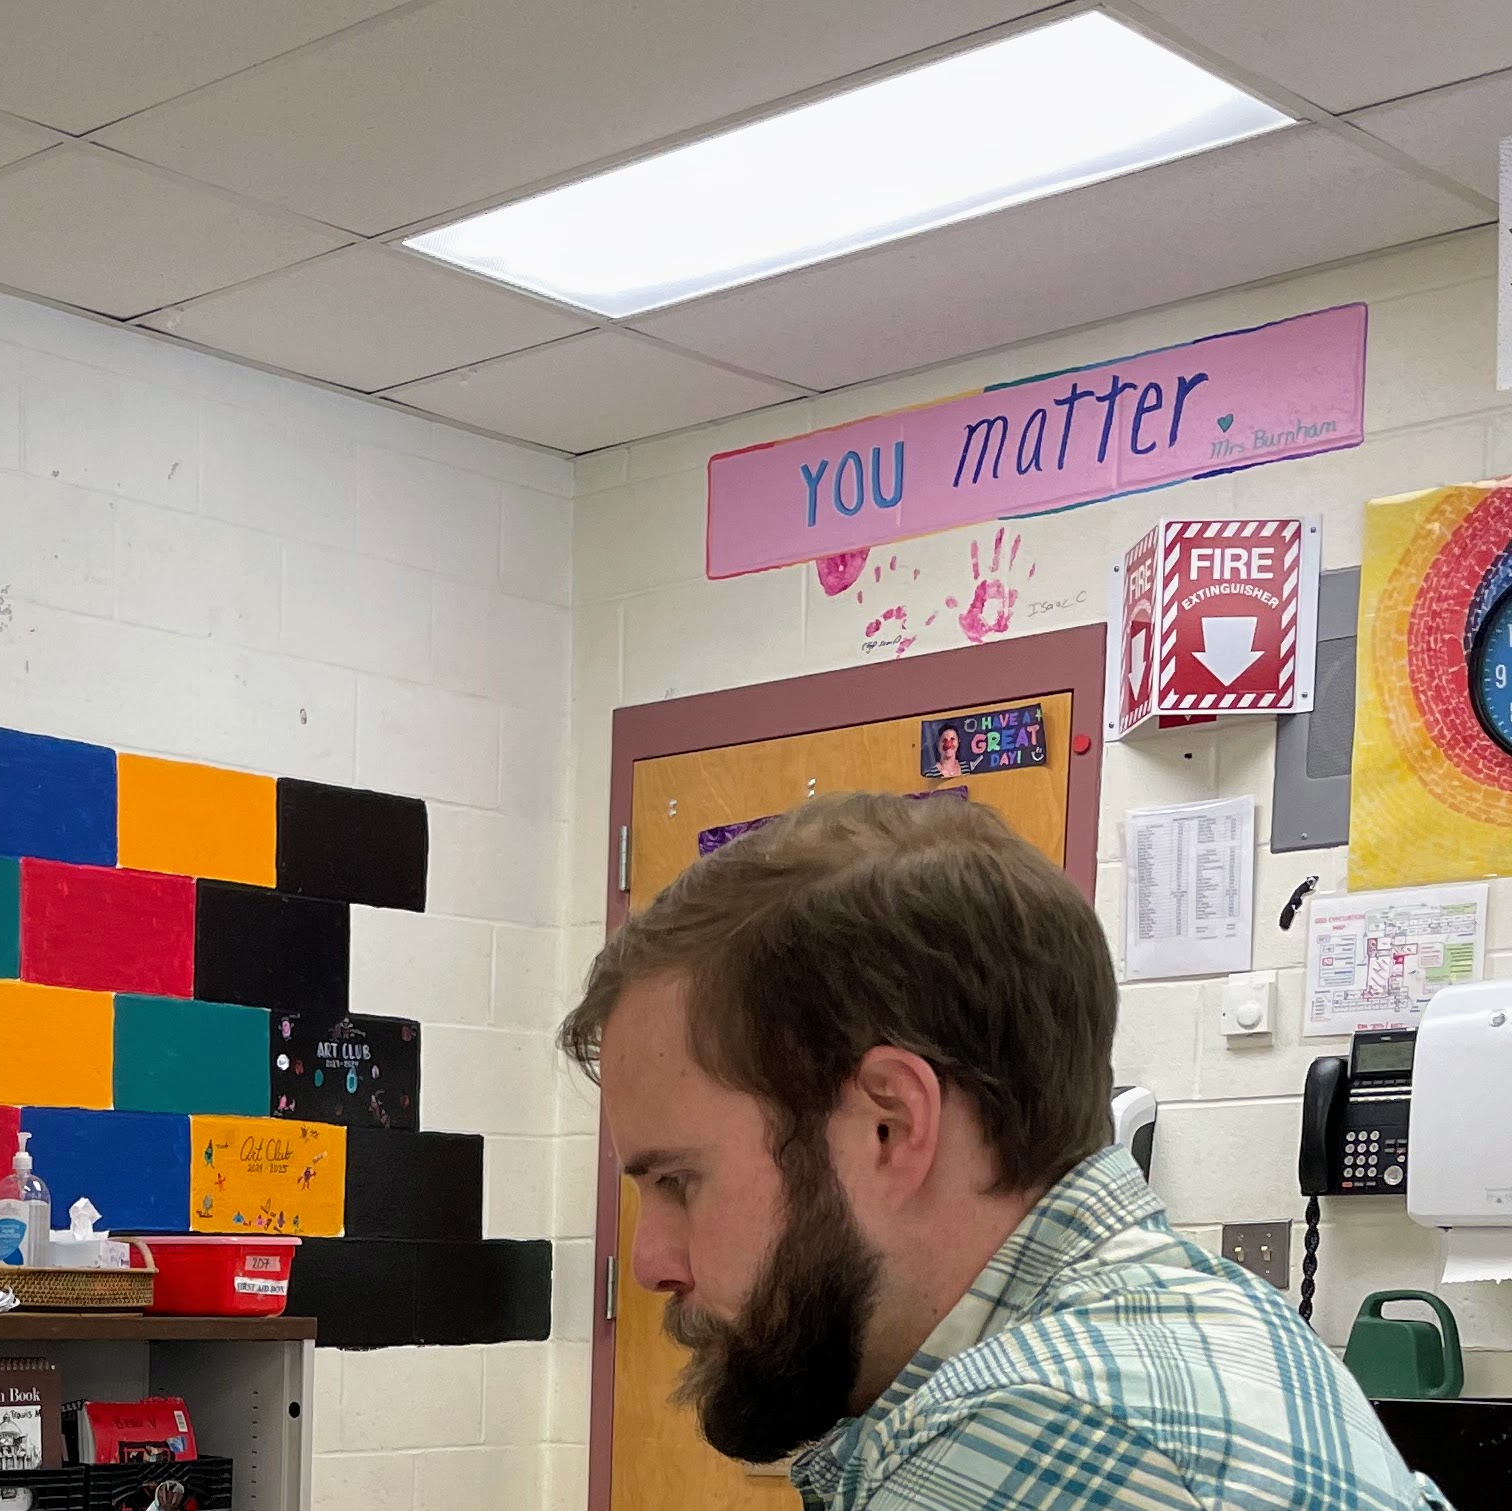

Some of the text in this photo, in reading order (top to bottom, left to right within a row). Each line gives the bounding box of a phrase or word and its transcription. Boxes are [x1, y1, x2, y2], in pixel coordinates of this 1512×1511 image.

[800, 372, 1209, 527] YOU matter
[1210, 417, 1337, 460] Mrs Burnham
[1189, 547, 1275, 581] FIRE
[1128, 557, 1153, 605] FIRE
[1181, 582, 1280, 611] EXTINGUISHER
[1495, 664, 1507, 689] 9
[981, 710, 1031, 731] HAVE A
[971, 724, 1040, 754] GREAT
[990, 750, 1022, 768] DAY!
[317, 1041, 372, 1060] ART CLUB
[240, 1136, 264, 1162] Art
[266, 1138, 293, 1161] Club
[9, 1387, 41, 1403] Book
